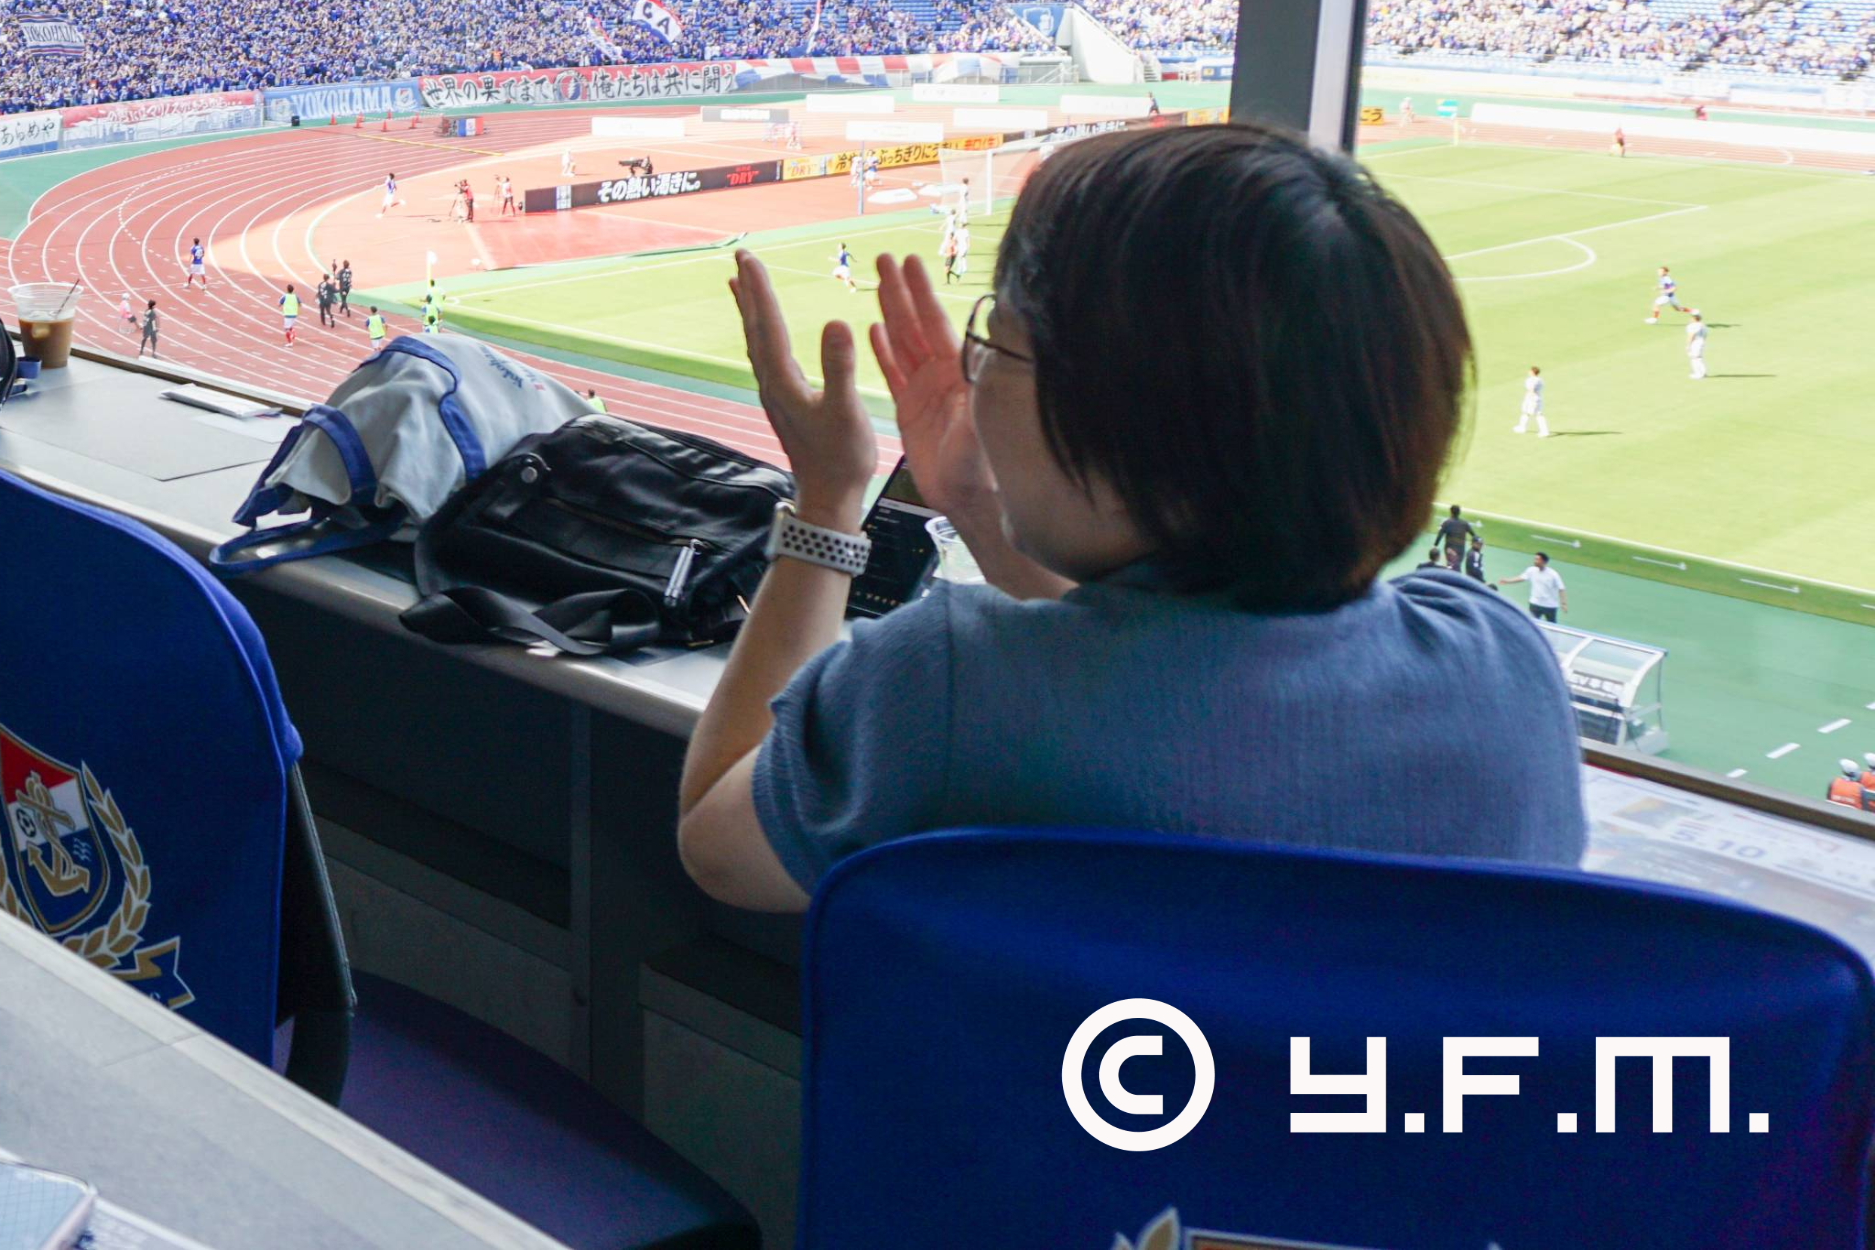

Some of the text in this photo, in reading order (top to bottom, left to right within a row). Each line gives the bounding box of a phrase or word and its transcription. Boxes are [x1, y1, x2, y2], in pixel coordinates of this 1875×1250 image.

[293, 86, 393, 118] YOKOHAMA
[424, 64, 735, 108] 世界の果てまで 俺たちは共に闘う
[598, 171, 701, 203] その熱い渇きに。
